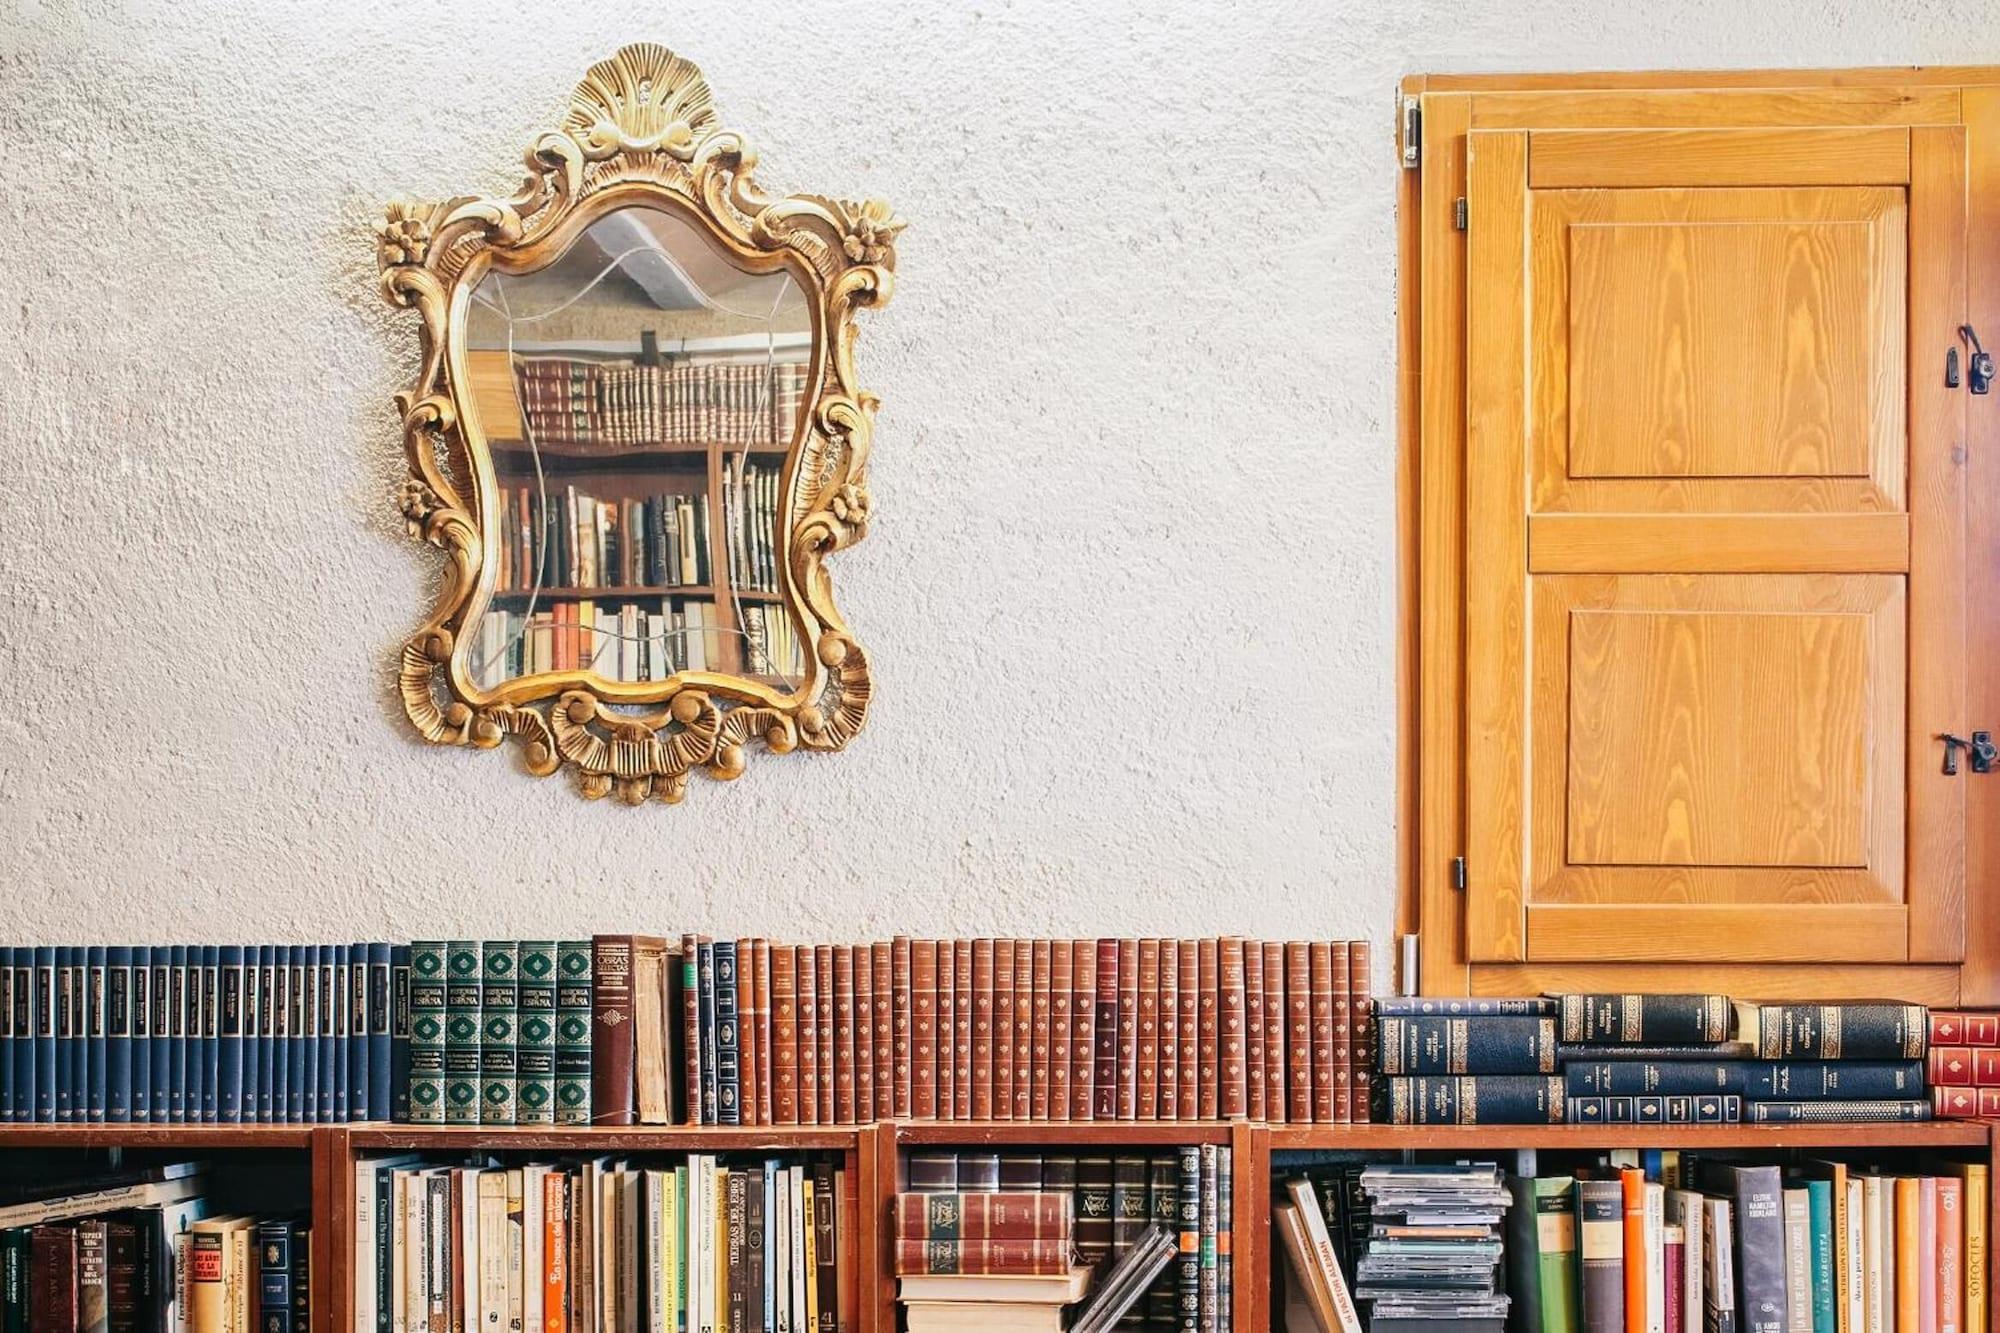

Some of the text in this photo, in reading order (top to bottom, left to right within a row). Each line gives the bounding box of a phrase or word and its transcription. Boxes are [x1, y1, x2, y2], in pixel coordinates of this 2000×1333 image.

[597, 956, 629, 964] OBRAS
[553, 1178, 562, 1221] unicornio
[553, 1222, 562, 1236] del
[730, 1178, 740, 1266] TIERRAS DEL EBRO
[178, 1244, 186, 1275] Delgado
[178, 1276, 184, 1284] G.
[550, 1266, 562, 1284] En
[510, 1318, 520, 1330] 45
